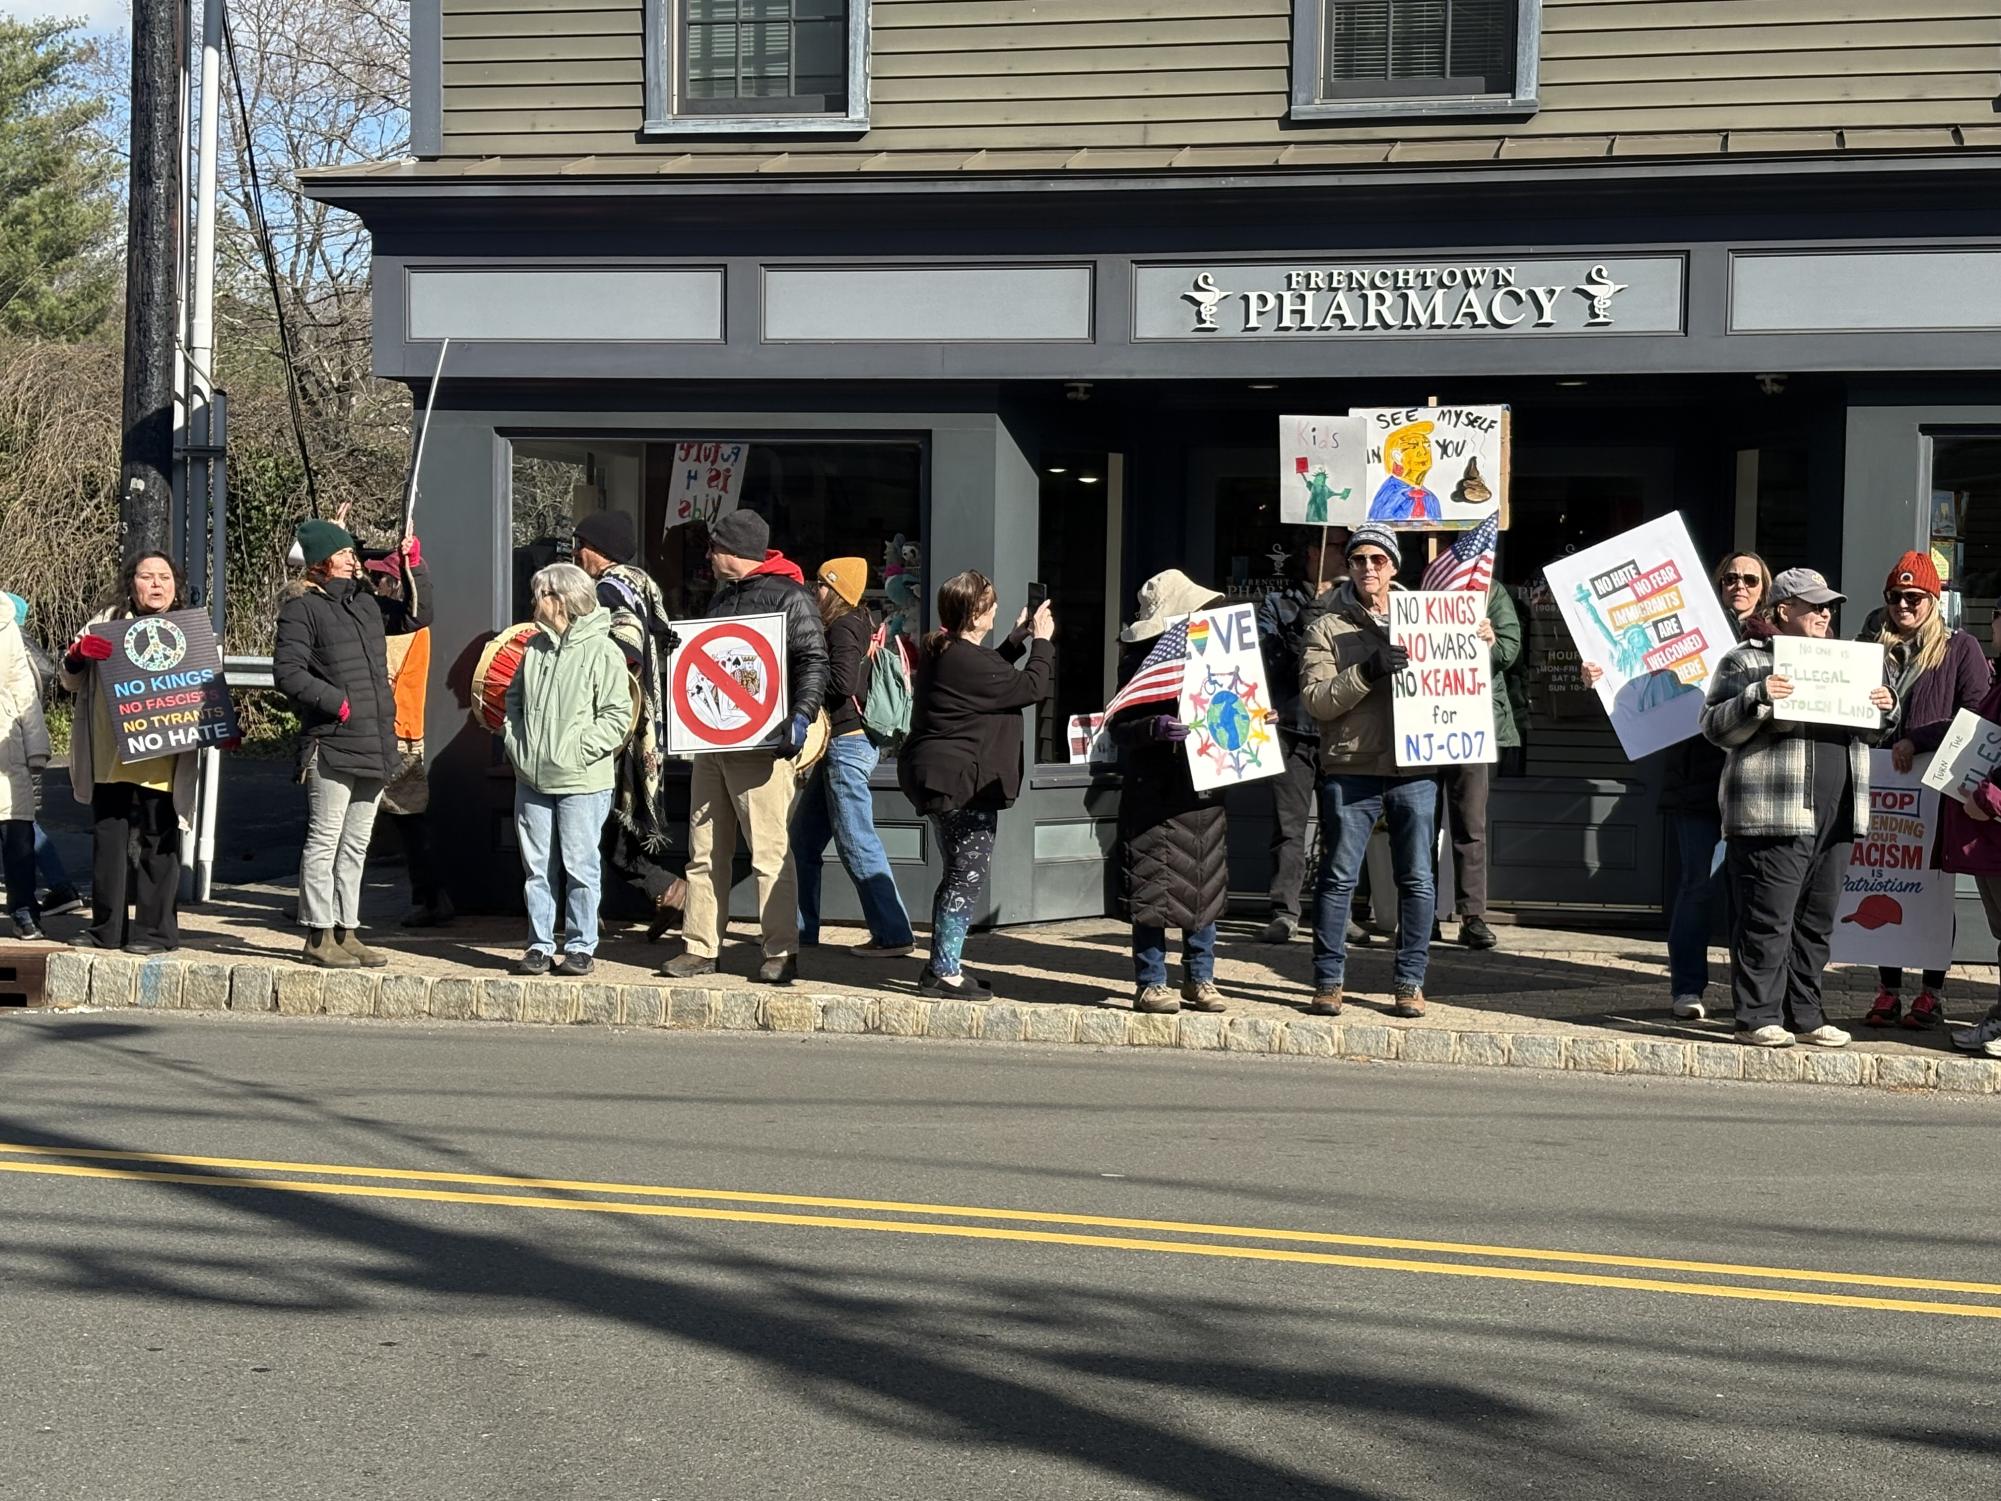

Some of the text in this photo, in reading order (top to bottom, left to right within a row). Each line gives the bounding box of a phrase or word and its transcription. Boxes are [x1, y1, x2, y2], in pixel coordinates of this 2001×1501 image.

[1287, 265, 1517, 289] FRENCHTOWN
[1242, 284, 1566, 331] PHARMACY
[1296, 420, 1340, 450] Kids
[1376, 408, 1499, 434] SEE MYSELF
[1435, 438, 1467, 460] YOU
[1593, 564, 1639, 596] NO HATE
[1633, 565, 1678, 598] NO FEAR
[1396, 595, 1476, 626] NO KINGS
[1613, 591, 1681, 626] IMMIGRANTS
[1657, 617, 1681, 639] ARE
[1397, 631, 1478, 663] NO WARS
[1646, 634, 1703, 671] WELCOMED
[113, 667, 215, 698] NO KINGS
[1394, 668, 1418, 699] NO
[1676, 658, 1703, 681] HERE
[1779, 662, 1851, 685] ILLEGAL
[118, 700, 143, 716] NO
[122, 705, 225, 733] NO TYRANTS
[1432, 705, 1457, 725] for
[1780, 696, 1875, 720] STOLEN LAND
[127, 722, 230, 755] NO HATE
[1405, 730, 1486, 763] NJ-CD7
[1932, 735, 1963, 781] TURN THE
[1870, 791, 1914, 810] TOP
[1870, 814, 1926, 840] ENDING
[1849, 842, 1924, 870] ACISM
[1871, 870, 1883, 879] IS
